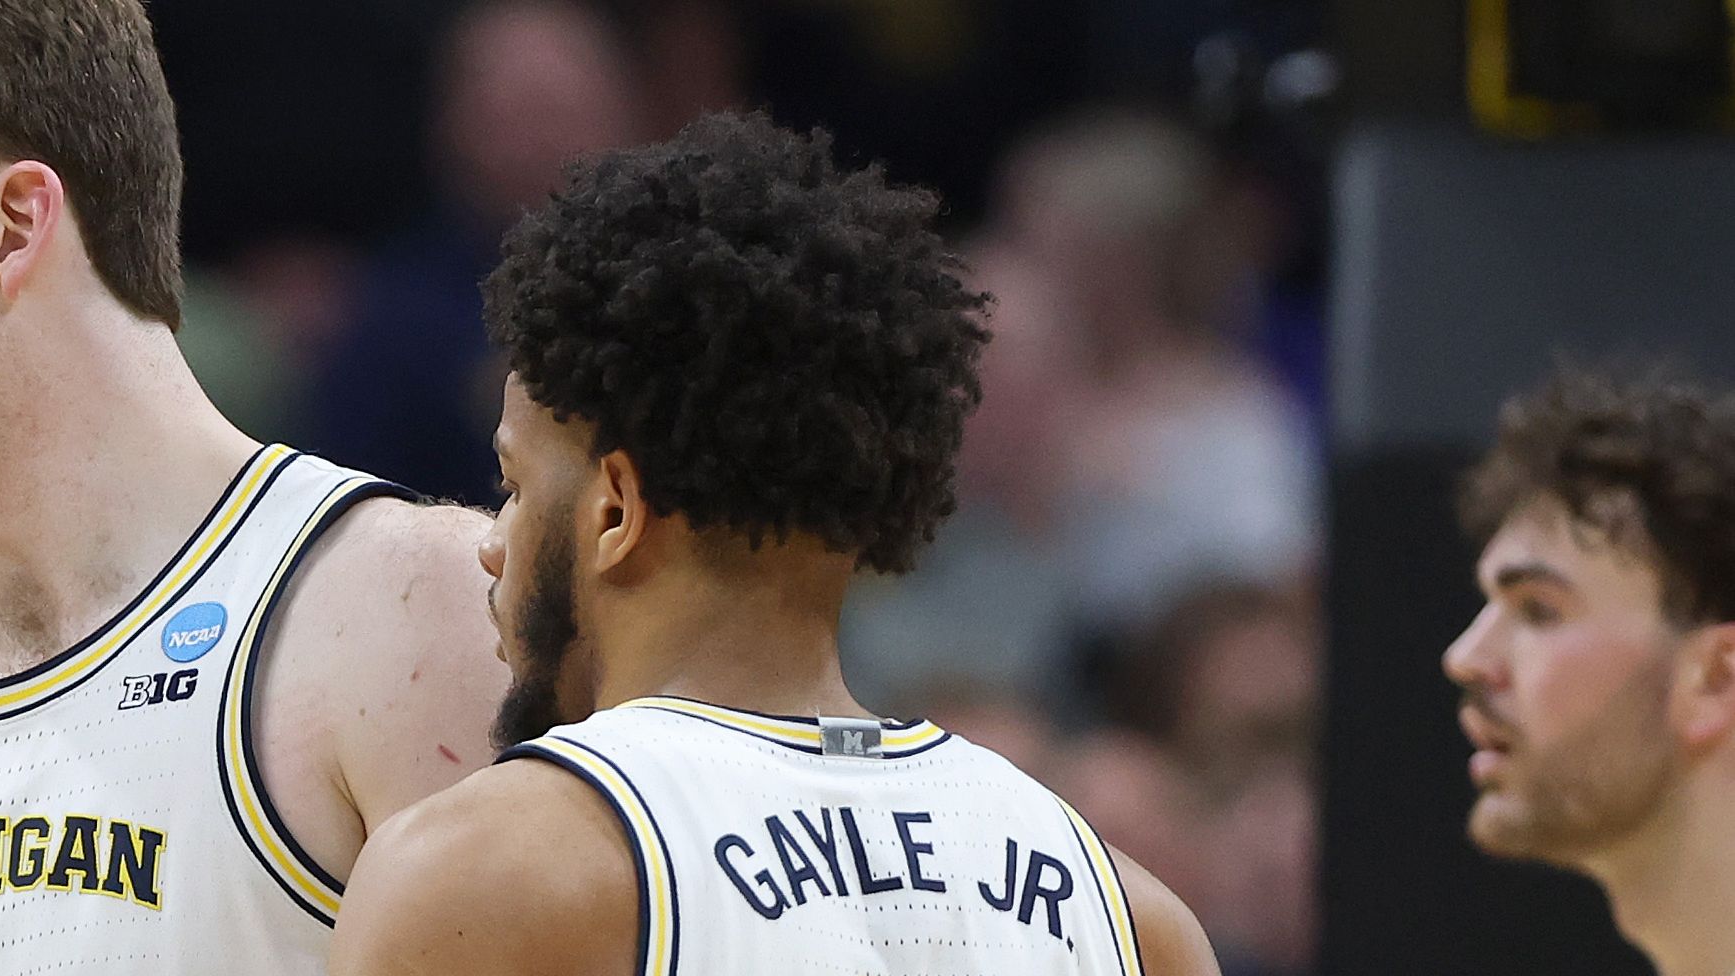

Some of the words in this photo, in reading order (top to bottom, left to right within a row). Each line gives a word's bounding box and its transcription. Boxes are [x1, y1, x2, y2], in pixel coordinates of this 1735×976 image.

[169, 624, 221, 649] NCAA
[713, 806, 947, 920] GAYLE
[977, 837, 1075, 953] JR.
